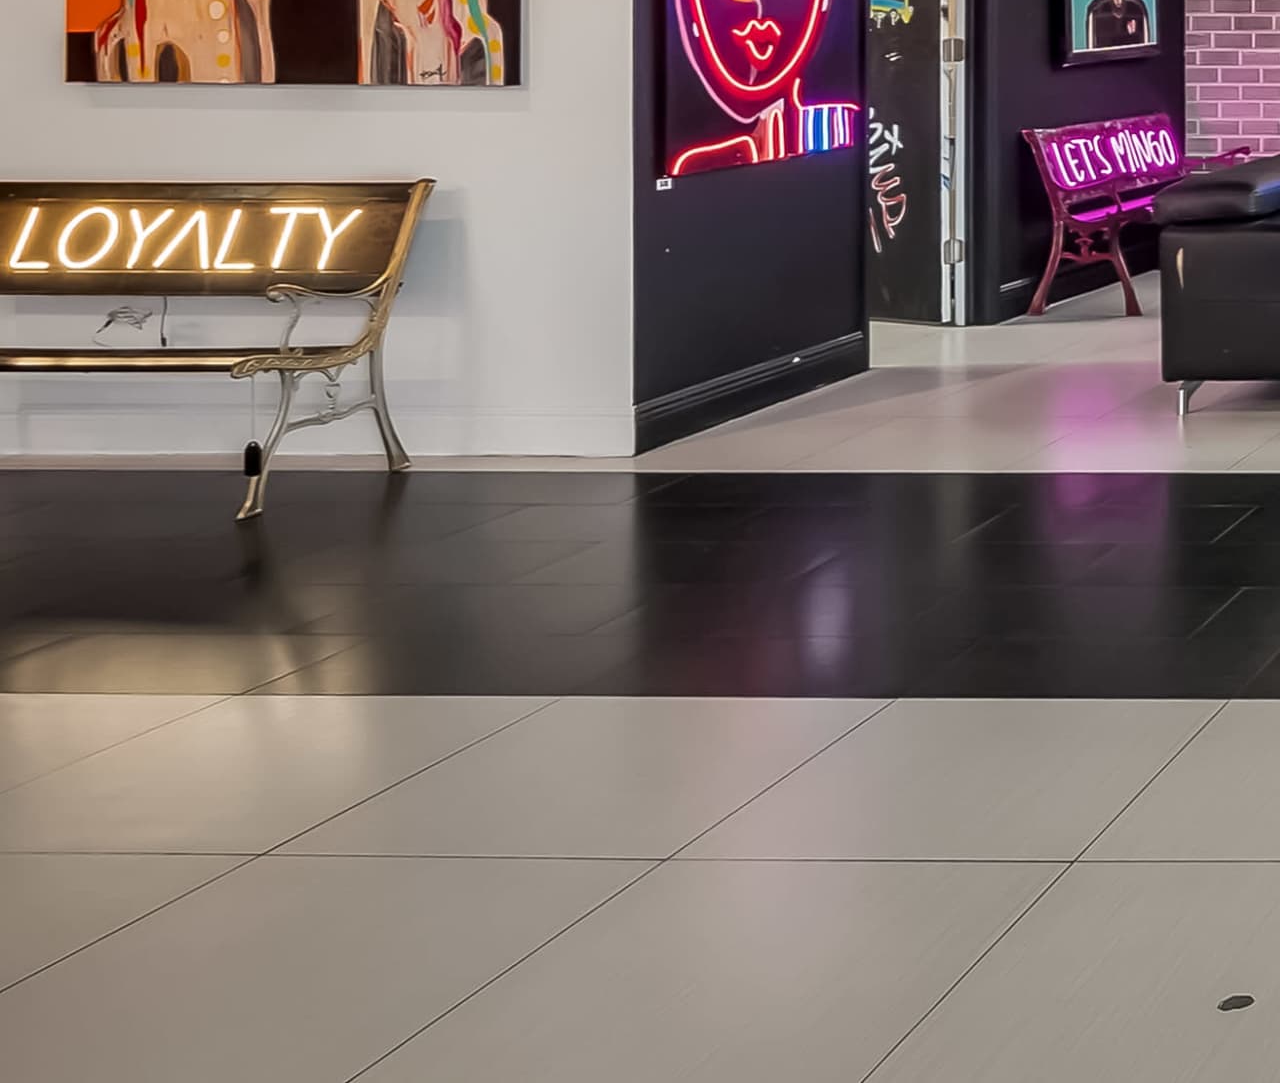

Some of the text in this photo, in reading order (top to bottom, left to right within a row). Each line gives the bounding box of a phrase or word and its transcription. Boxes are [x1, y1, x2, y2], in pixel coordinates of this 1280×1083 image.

[1051, 129, 1176, 186] LET'S MINGO
[8, 205, 364, 272] LOYALTY
